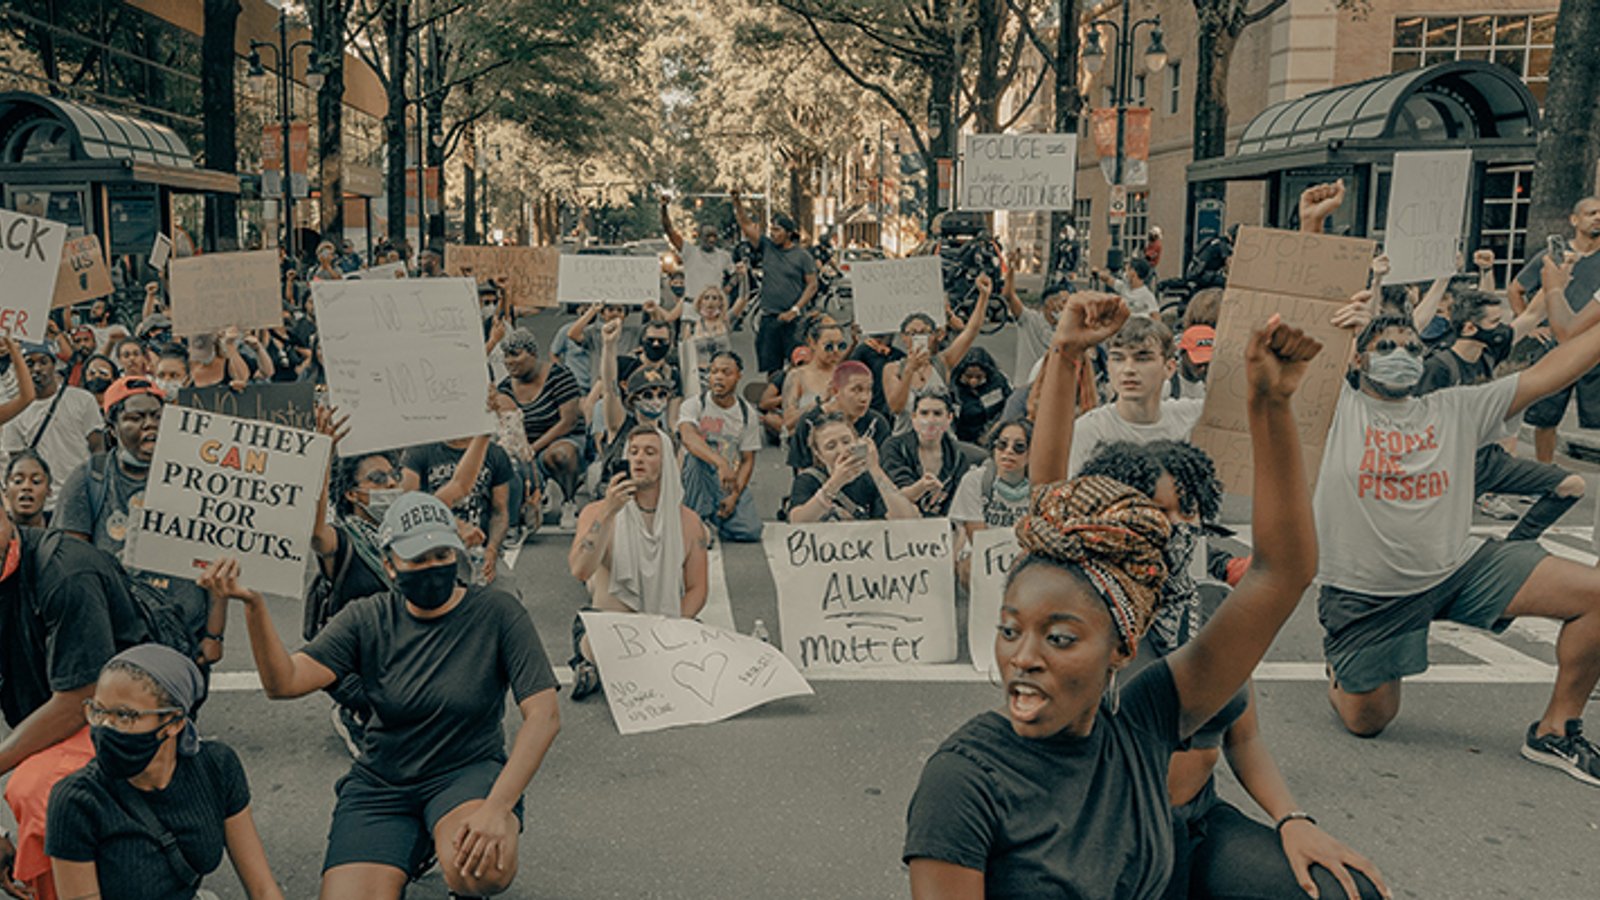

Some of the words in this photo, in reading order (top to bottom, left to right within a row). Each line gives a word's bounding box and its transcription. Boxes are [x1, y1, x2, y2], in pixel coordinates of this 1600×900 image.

[972, 137, 1042, 160] POLICE
[0, 217, 51, 262] CK
[1238, 231, 1322, 263] STOP
[1273, 261, 1321, 286] THE
[369, 292, 402, 331] NO
[385, 361, 418, 406] NO
[178, 409, 213, 436] IF
[230, 420, 315, 456] THEY
[199, 439, 269, 476] CAN
[1360, 447, 1407, 476] ARE
[163, 461, 303, 509] PROTEST
[1358, 470, 1450, 501] PISSED!
[199, 496, 256, 530] FOR
[400, 503, 450, 532] HEELS
[787, 529, 875, 567] Black
[822, 569, 929, 611] ALWAYS
